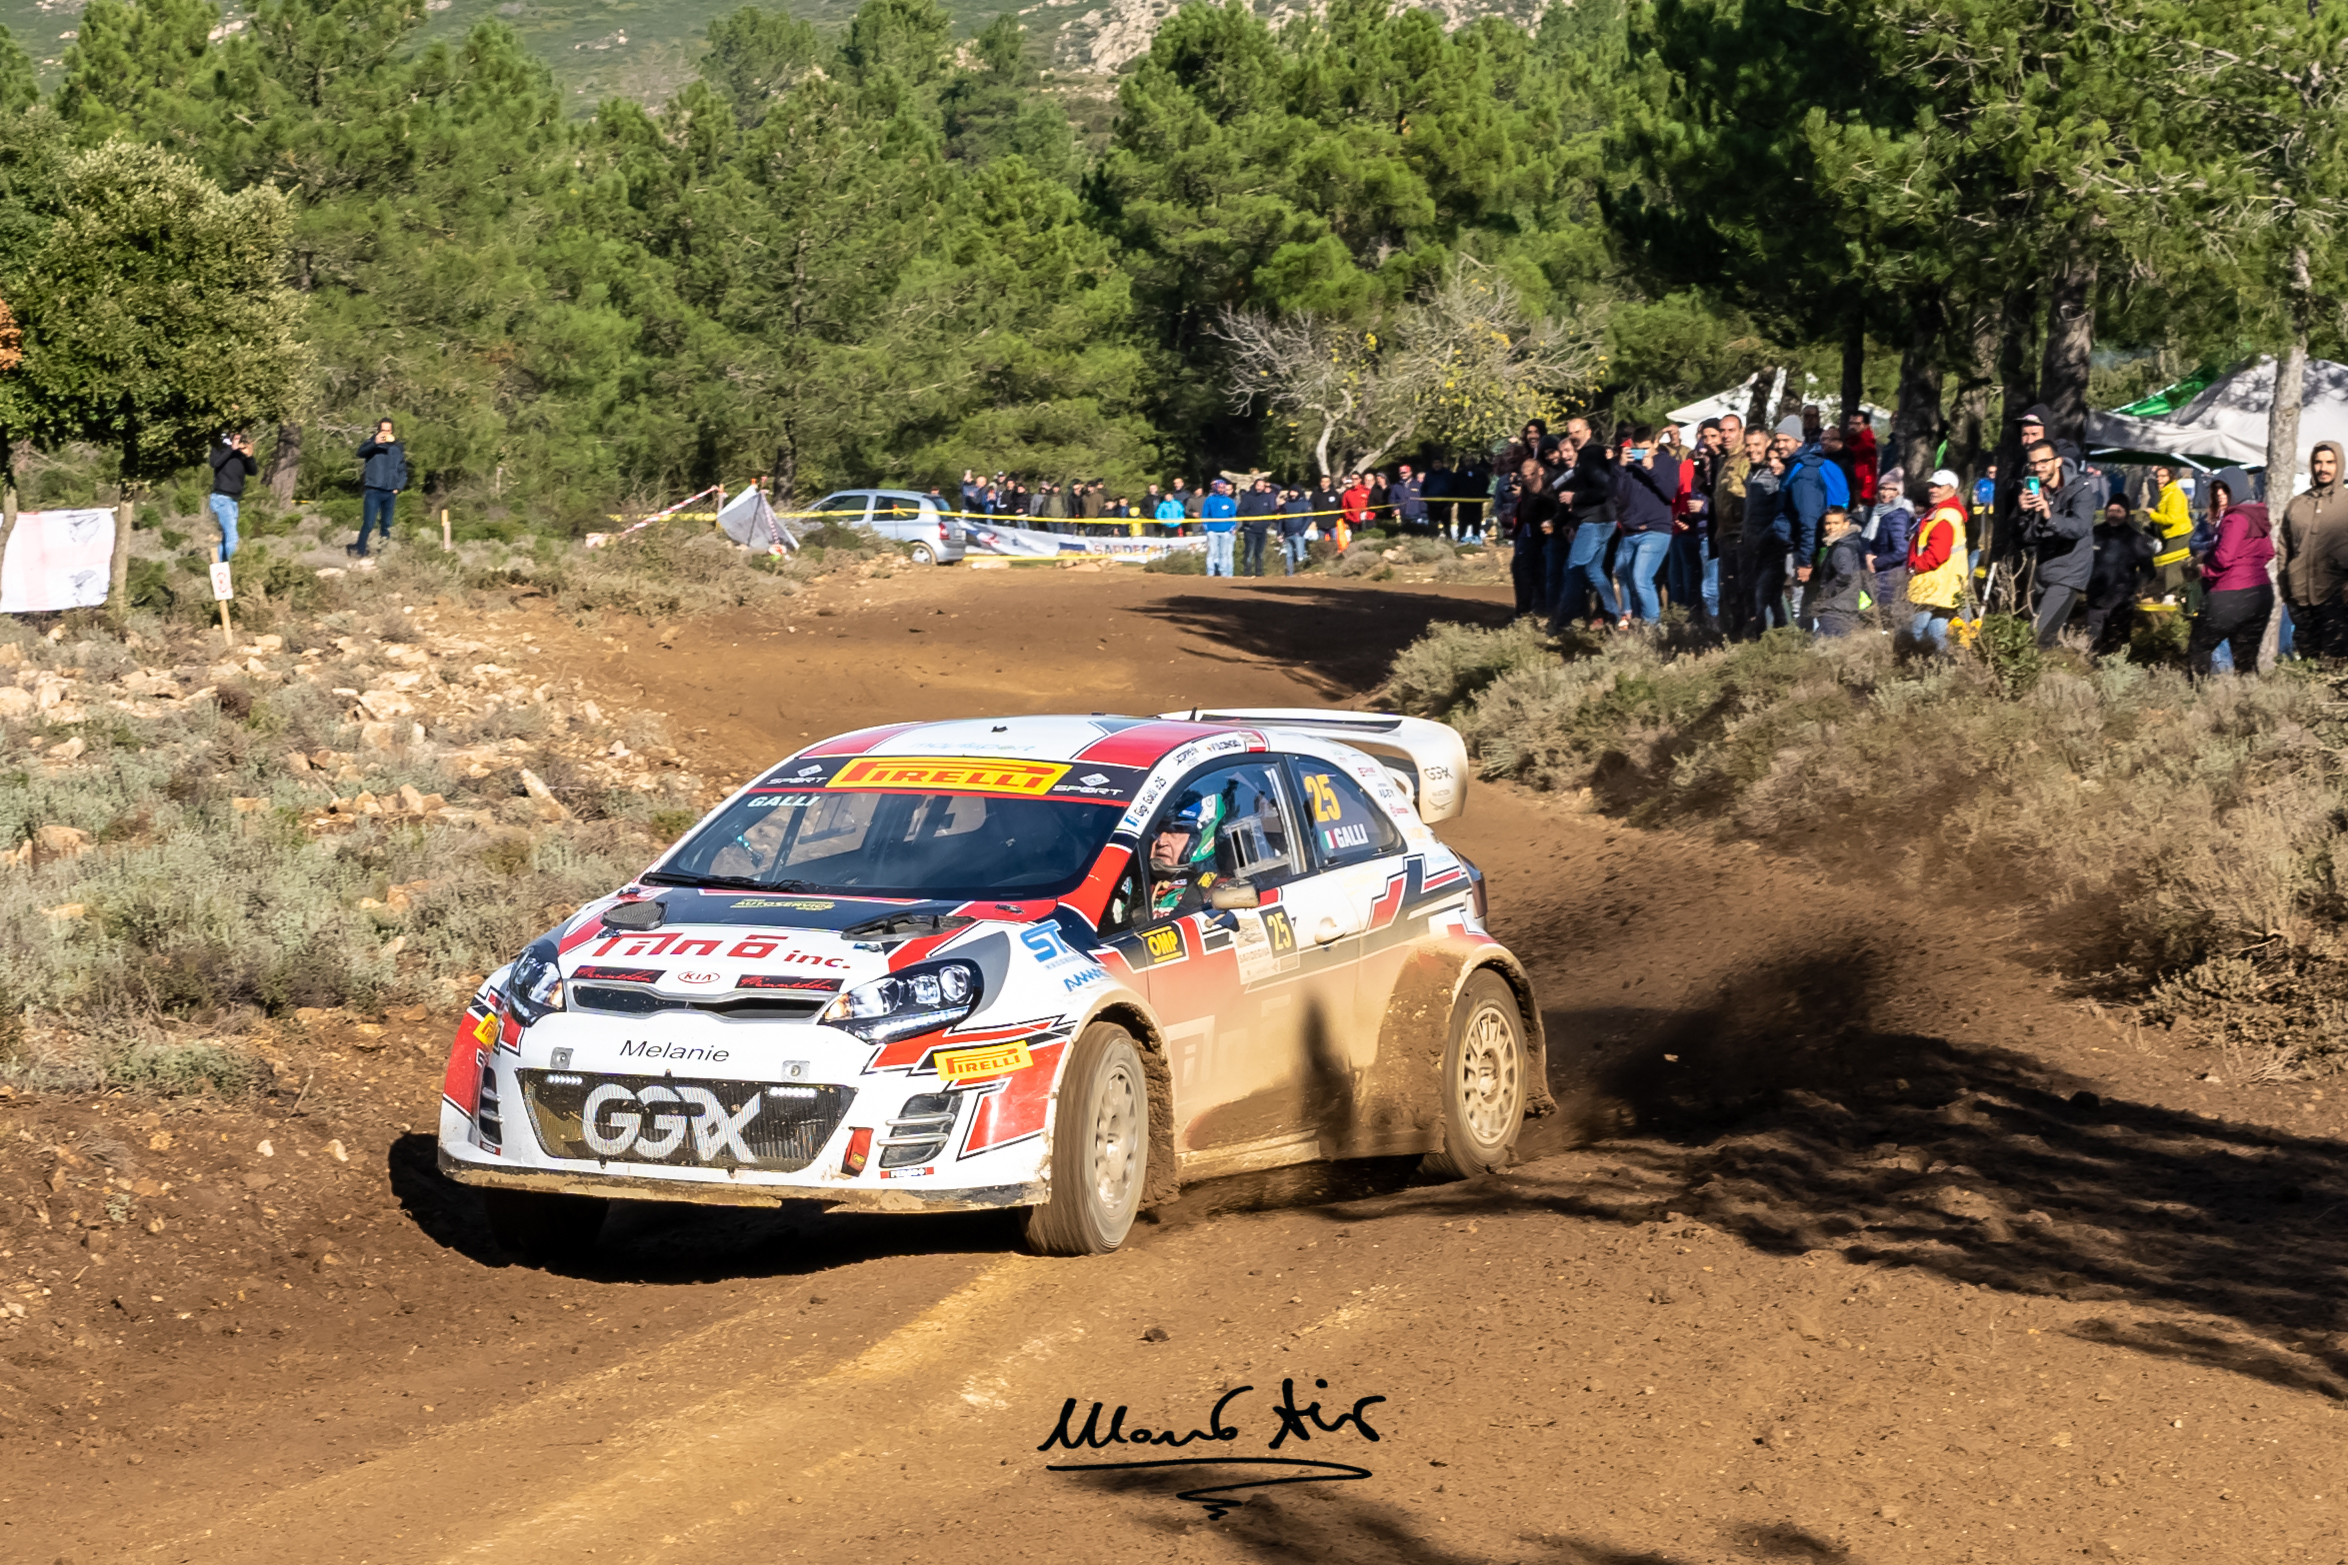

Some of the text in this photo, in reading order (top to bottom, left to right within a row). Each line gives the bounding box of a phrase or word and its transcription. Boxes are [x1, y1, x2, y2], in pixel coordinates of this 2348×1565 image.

[766, 776, 828, 785] SPORT
[840, 761, 1056, 788] PIRELLI
[748, 795, 821, 808] GALLI
[1052, 784, 1123, 796] SPORT
[1304, 774, 1341, 823] 25
[1334, 823, 1369, 849] GALLI
[1146, 929, 1179, 957] OMP
[1267, 912, 1292, 951] 25
[784, 950, 850, 969] inc.
[683, 972, 711, 982] KIA
[619, 1040, 730, 1062] Melanie
[946, 1048, 1021, 1074] PIRELLI
